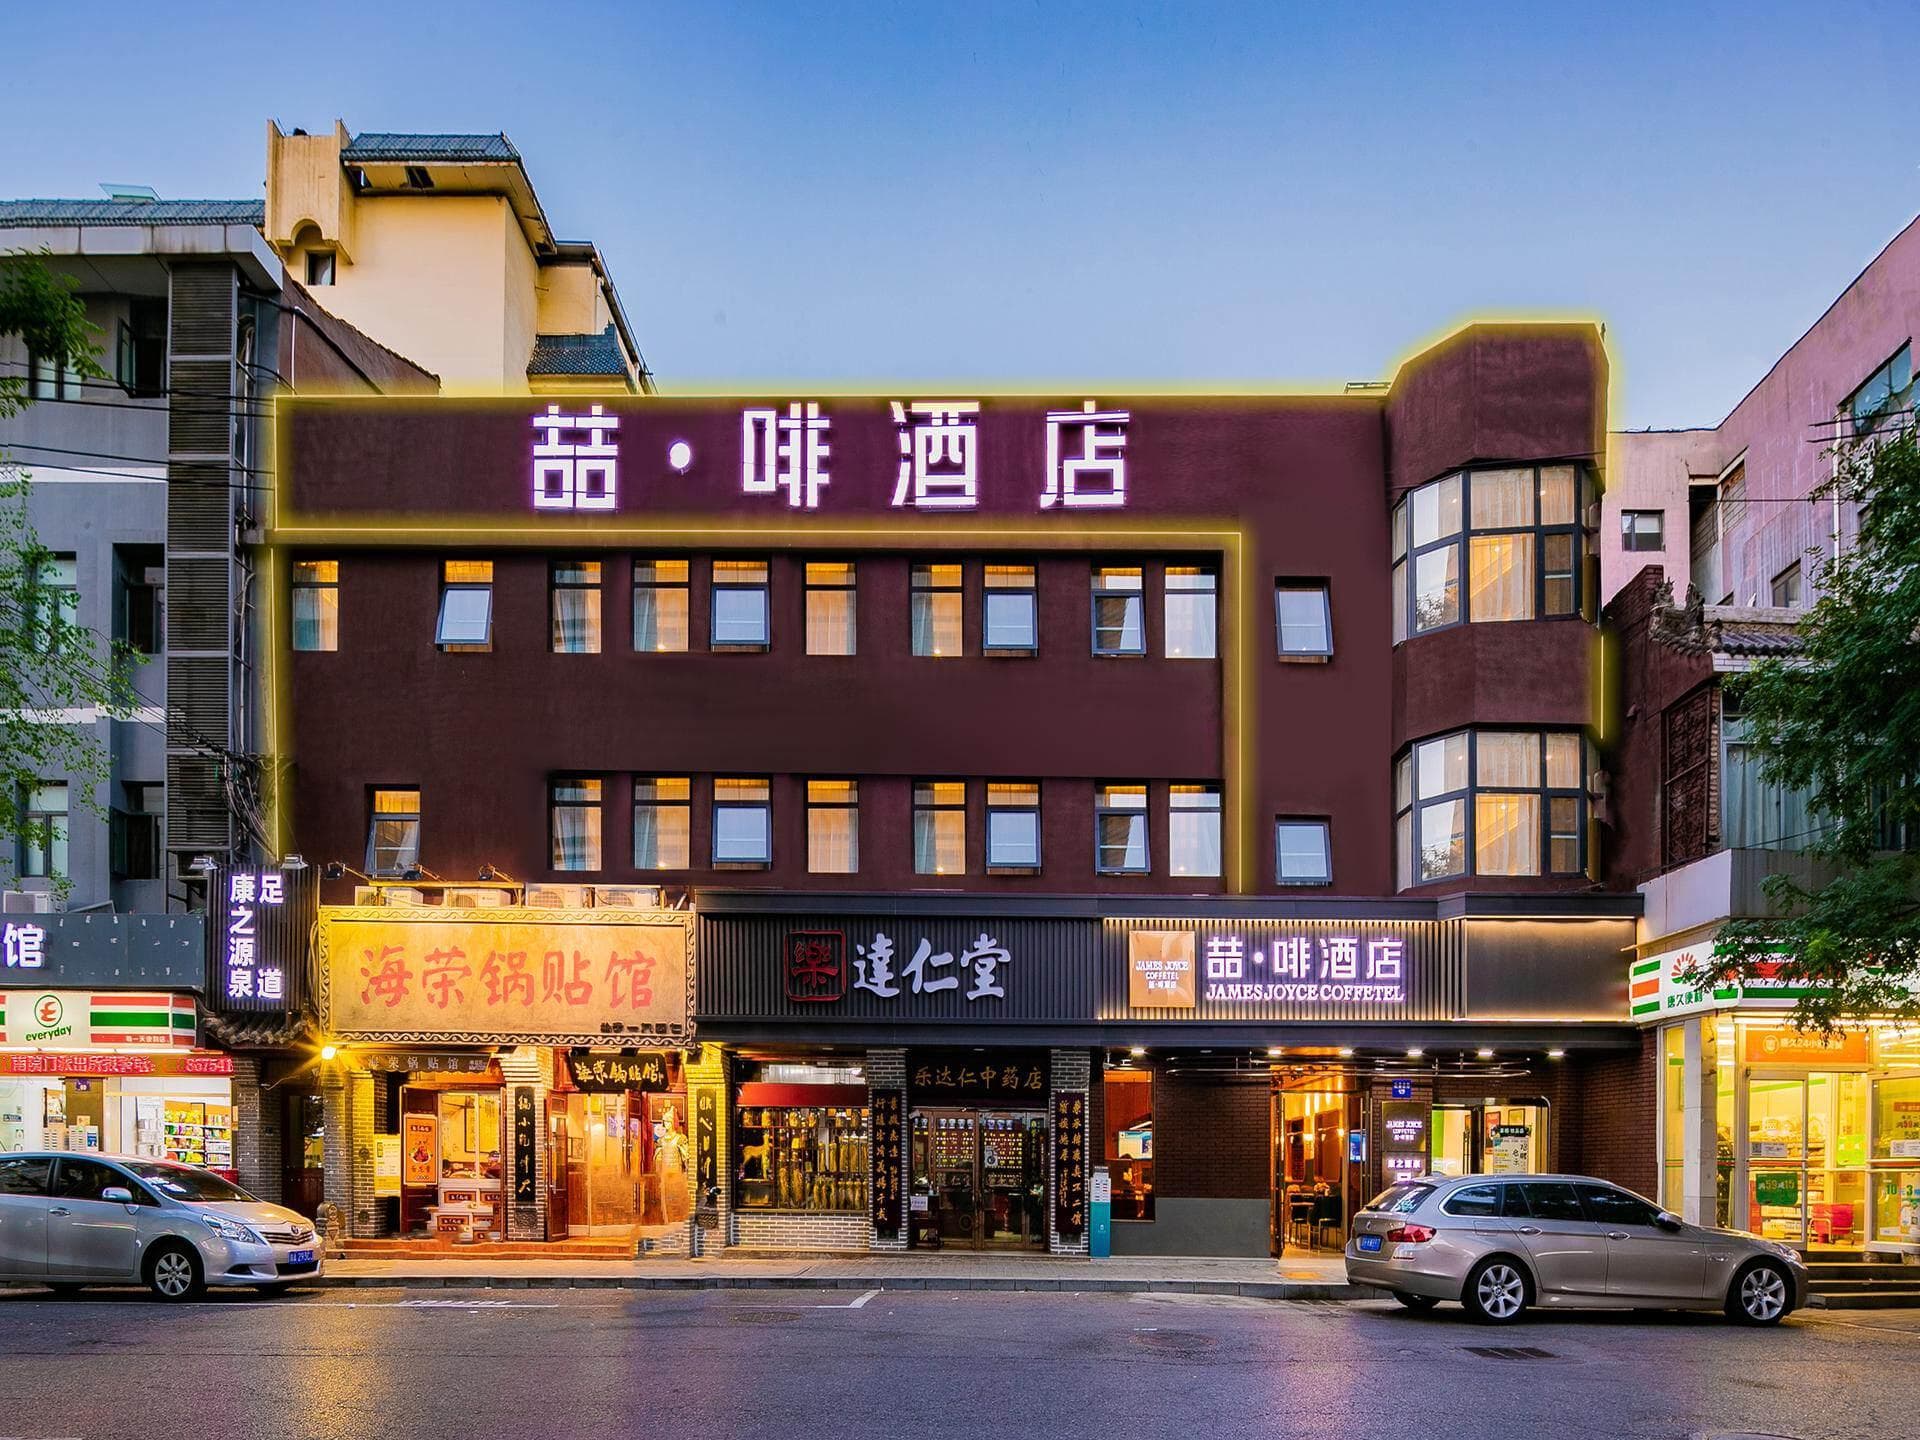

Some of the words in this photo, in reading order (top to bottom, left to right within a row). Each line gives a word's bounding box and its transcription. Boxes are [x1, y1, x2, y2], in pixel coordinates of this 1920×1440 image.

[2, 923, 46, 968] 馆
[228, 873, 256, 999] 康之源泉
[852, 932, 1012, 1001] 達仁堂
[1135, 960, 1163, 971] JAMES
[1164, 960, 1189, 971] JOYCE
[1145, 971, 1180, 980] COFFETEL
[359, 945, 659, 1010] 海荣锅贴馆
[1206, 984, 1264, 1002] JAMES
[1264, 984, 1320, 1002] JOYCE
[1320, 984, 1406, 1002] COFFETEL
[25, 1023, 73, 1042] everyday
[367, 1055, 459, 1070] 海荣锅贴馆
[914, 1065, 1043, 1090] 乐达仁中药店
